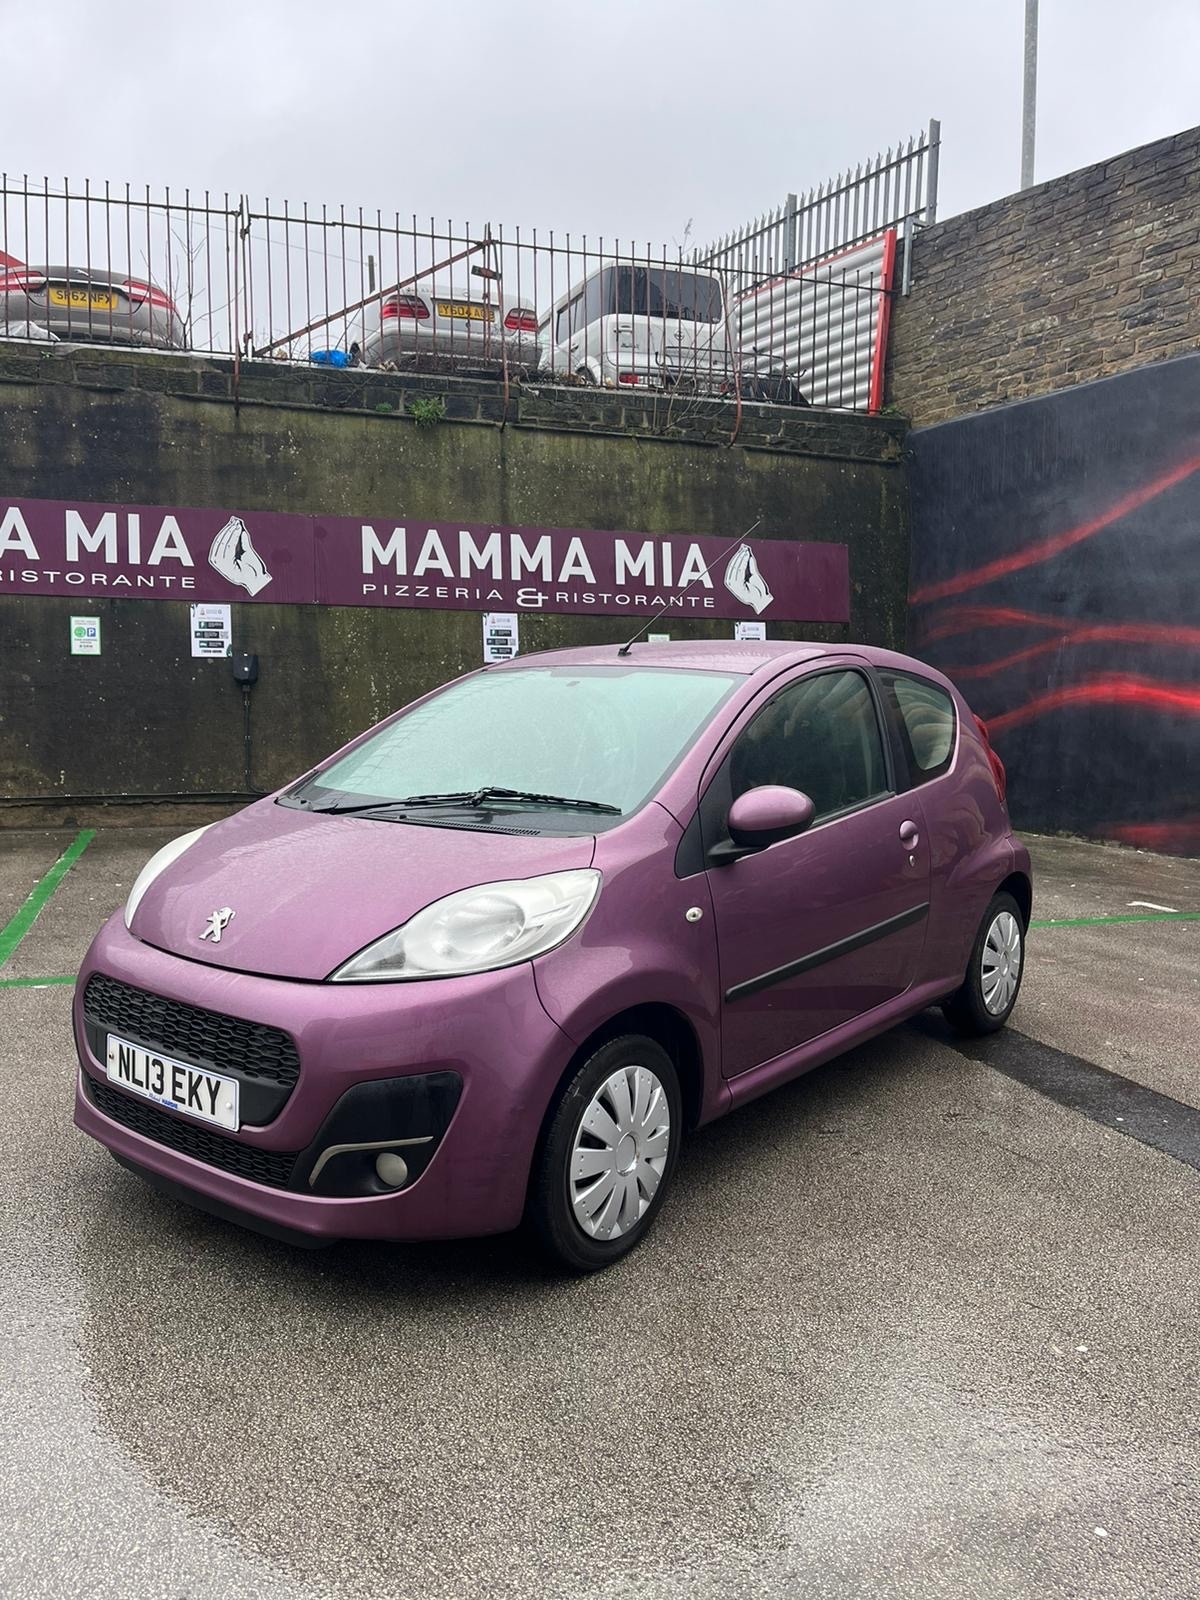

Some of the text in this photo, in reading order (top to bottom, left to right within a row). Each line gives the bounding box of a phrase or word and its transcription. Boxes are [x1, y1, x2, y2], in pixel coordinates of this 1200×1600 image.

[65, 509, 195, 567] MIA
[361, 525, 714, 589] MAMMA MIA
[0, 569, 196, 589] ISTORANTE
[362, 584, 503, 601] PIZZERIA
[555, 592, 715, 608] RISTORANTE
[118, 1043, 221, 1116] NL13 EKY
